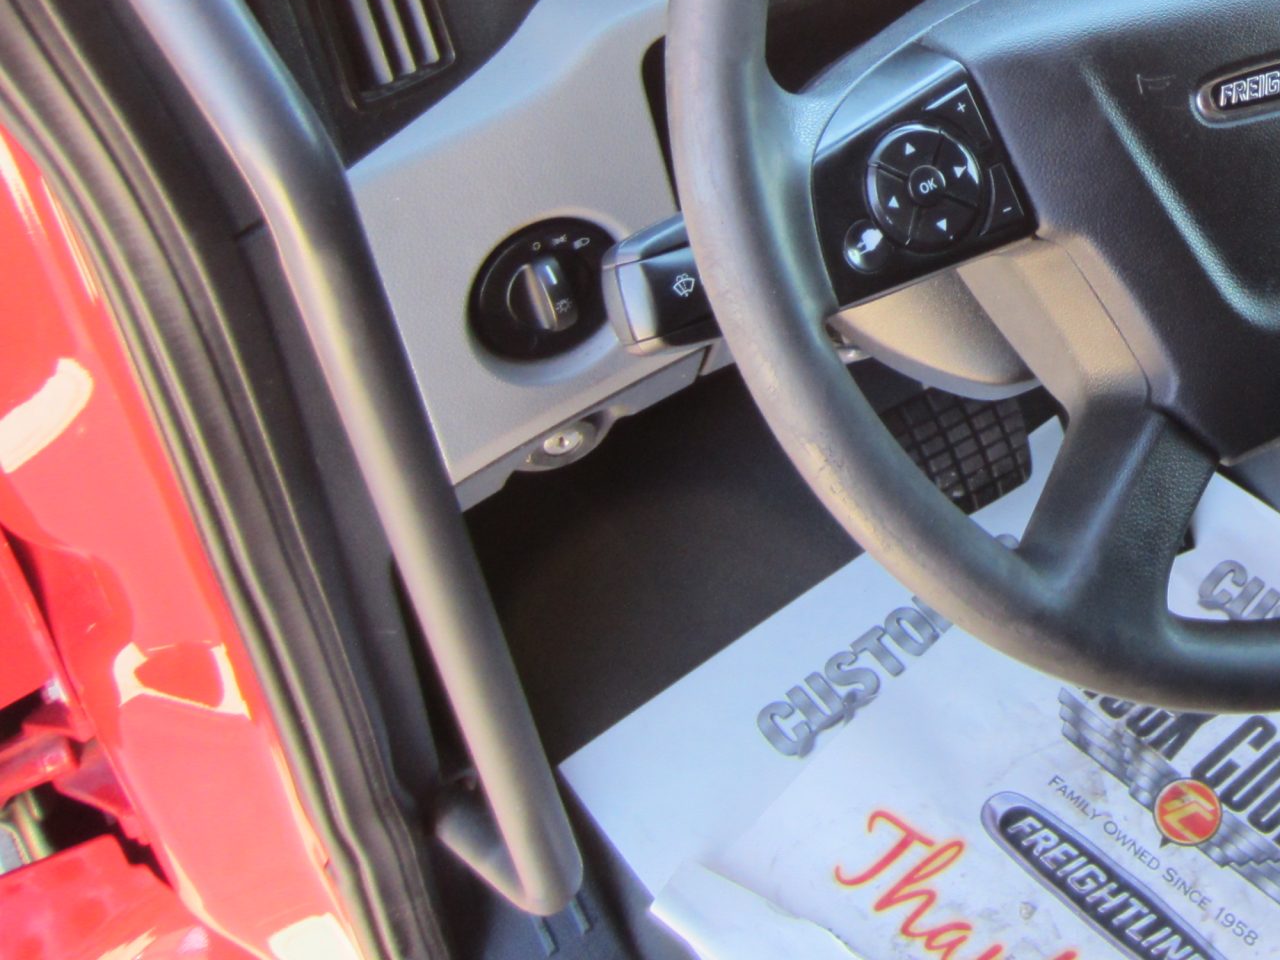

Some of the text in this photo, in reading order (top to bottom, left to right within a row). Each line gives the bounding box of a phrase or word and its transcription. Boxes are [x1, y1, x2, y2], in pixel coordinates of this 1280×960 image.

[919, 178, 937, 195] OK
[1007, 815, 1207, 960] FREIGHTLIN
[1047, 774, 1260, 947] FAMILY OWNED SINCE 1958
